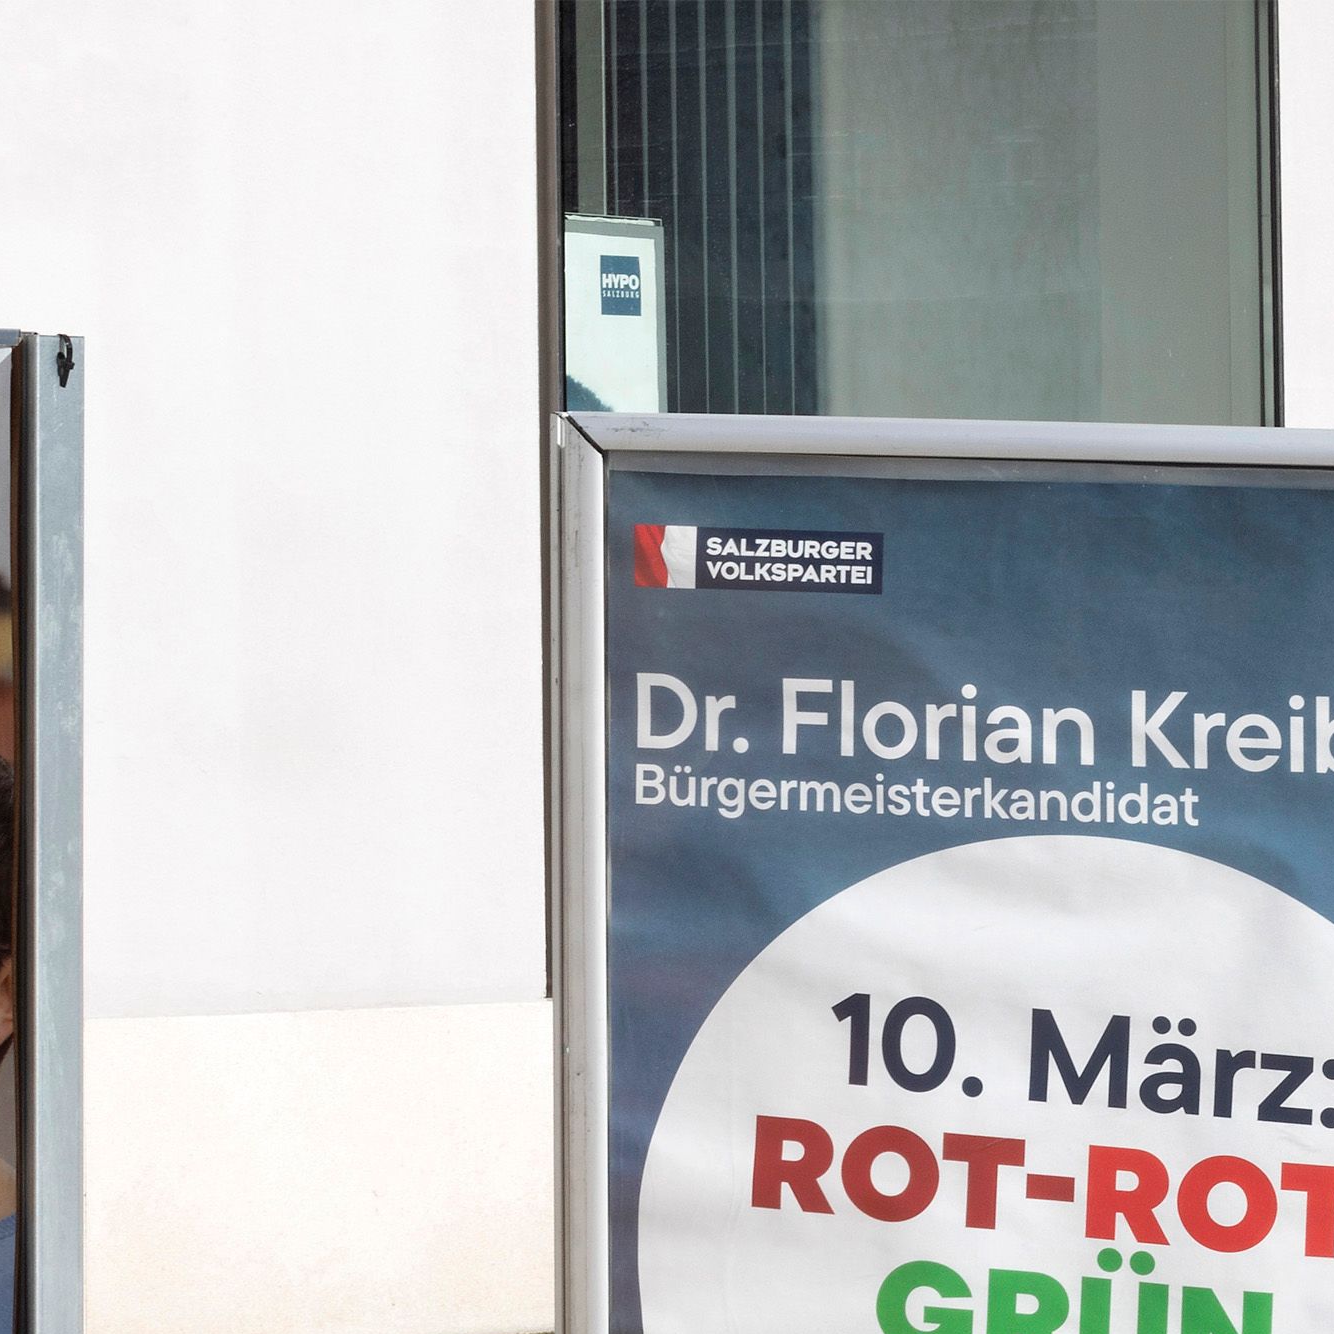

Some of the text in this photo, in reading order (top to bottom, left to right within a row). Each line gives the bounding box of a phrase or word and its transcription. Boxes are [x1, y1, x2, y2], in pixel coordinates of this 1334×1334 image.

[603, 274, 639, 289] HYPO
[603, 290, 639, 298] SALZBURG
[707, 537, 872, 560] SALZBURGER
[707, 561, 872, 584] VOLKSPARTEI
[637, 673, 749, 753] Dr.
[783, 678, 1094, 765] Florian
[636, 764, 1199, 826] Bürgermeisterkandidat
[832, 993, 983, 1097] 10.
